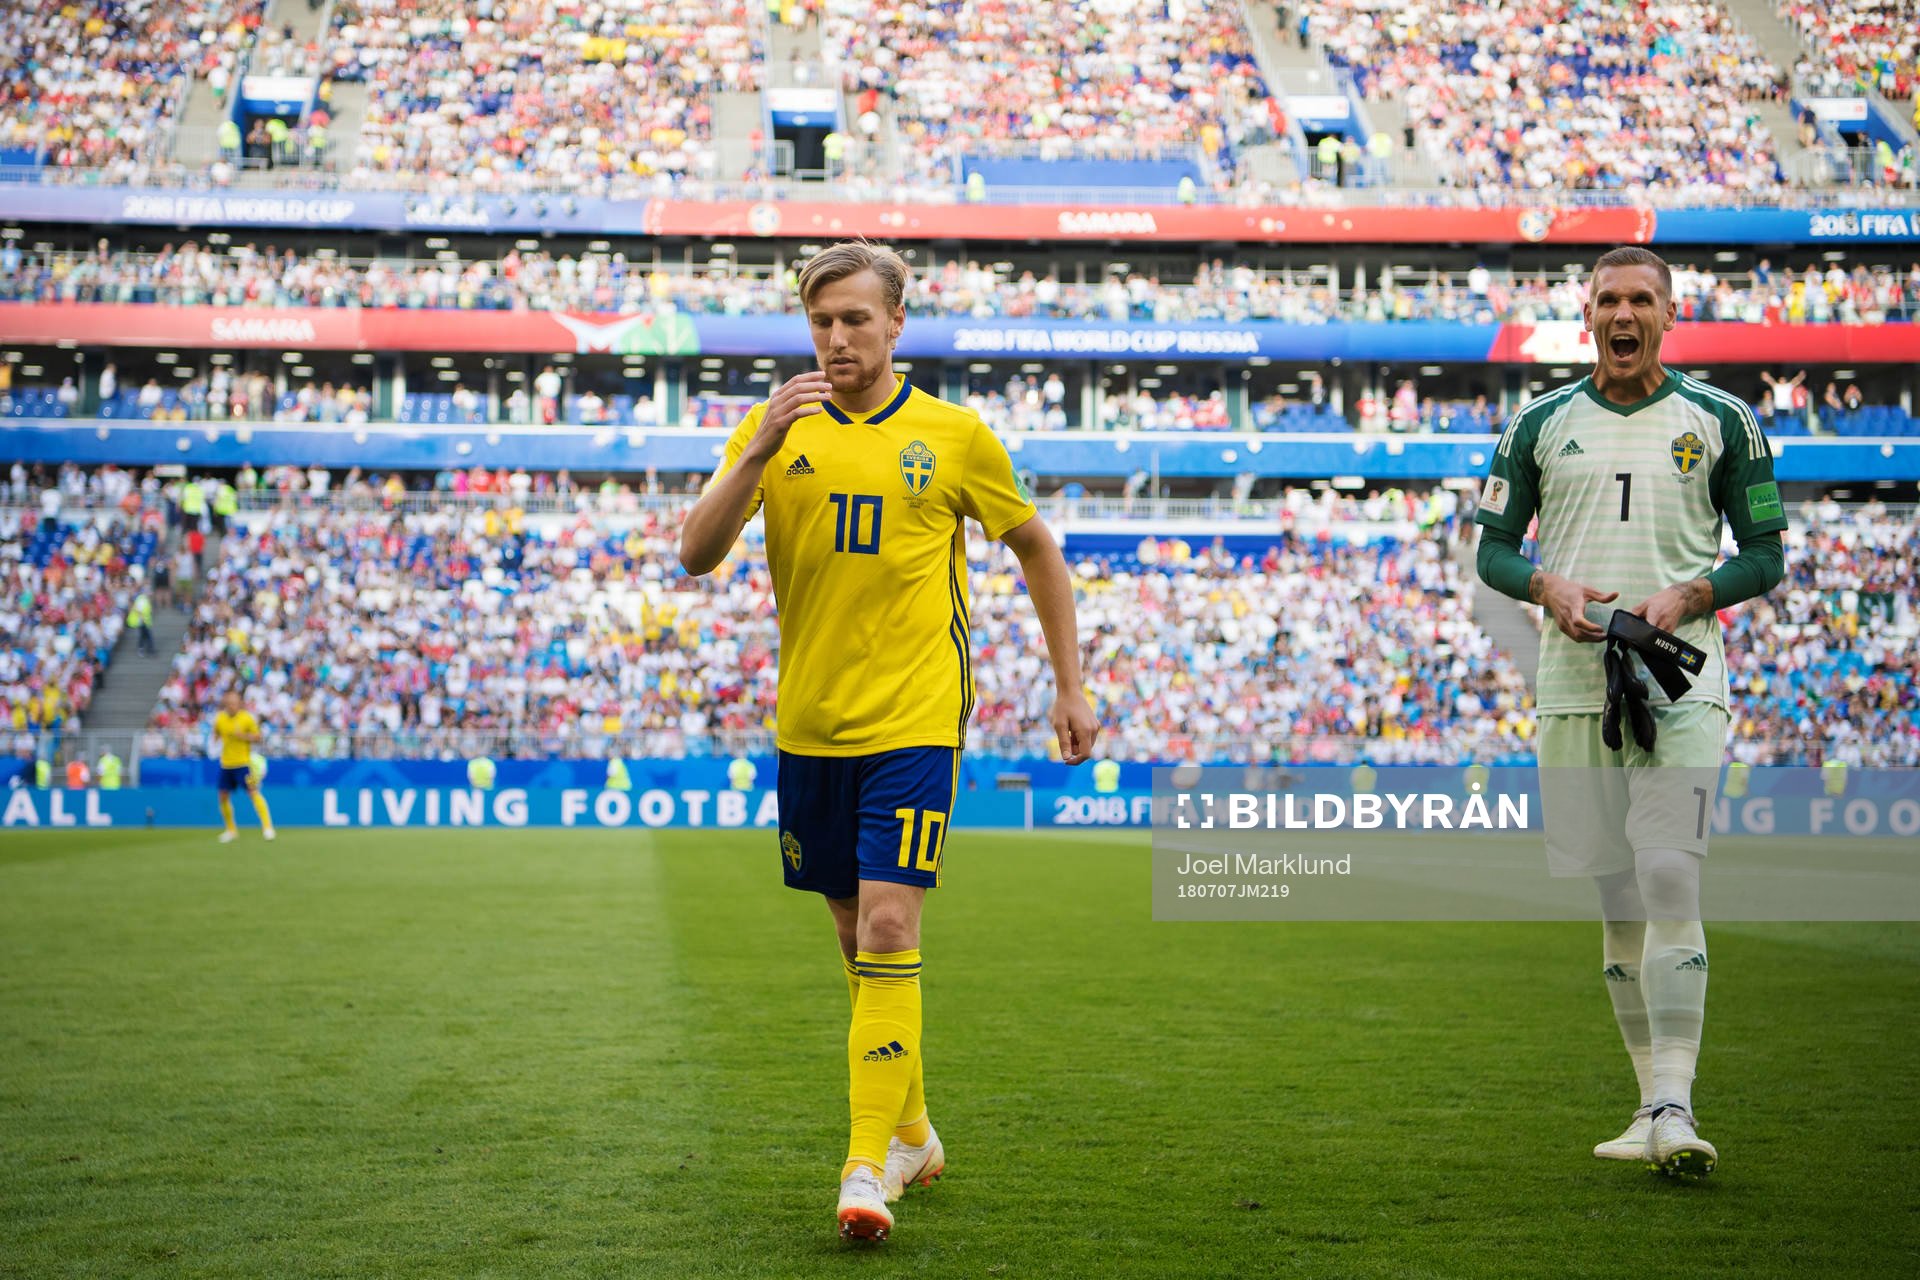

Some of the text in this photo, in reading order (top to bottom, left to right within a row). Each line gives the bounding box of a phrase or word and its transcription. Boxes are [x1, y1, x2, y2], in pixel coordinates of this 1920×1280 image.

[175, 197, 224, 220] FIFA
[225, 198, 304, 222] WORLD
[304, 199, 355, 223] CUP
[1058, 211, 1157, 234] SAMARA
[1809, 214, 1859, 236] 2018
[1862, 214, 1909, 236] FIFA
[211, 317, 316, 341] SAMARA
[953, 328, 1260, 353] 2018 FIFA WORLD CUP RUSSIA
[1615, 473, 1632, 522] 1
[829, 492, 884, 555] 10
[1654, 637, 1678, 654] OLSEN
[2, 788, 112, 827] ALL
[323, 788, 529, 827] LIVING
[1053, 796, 1128, 825] 2018
[895, 808, 946, 872] 10
[863, 1050, 909, 1062] adidas
